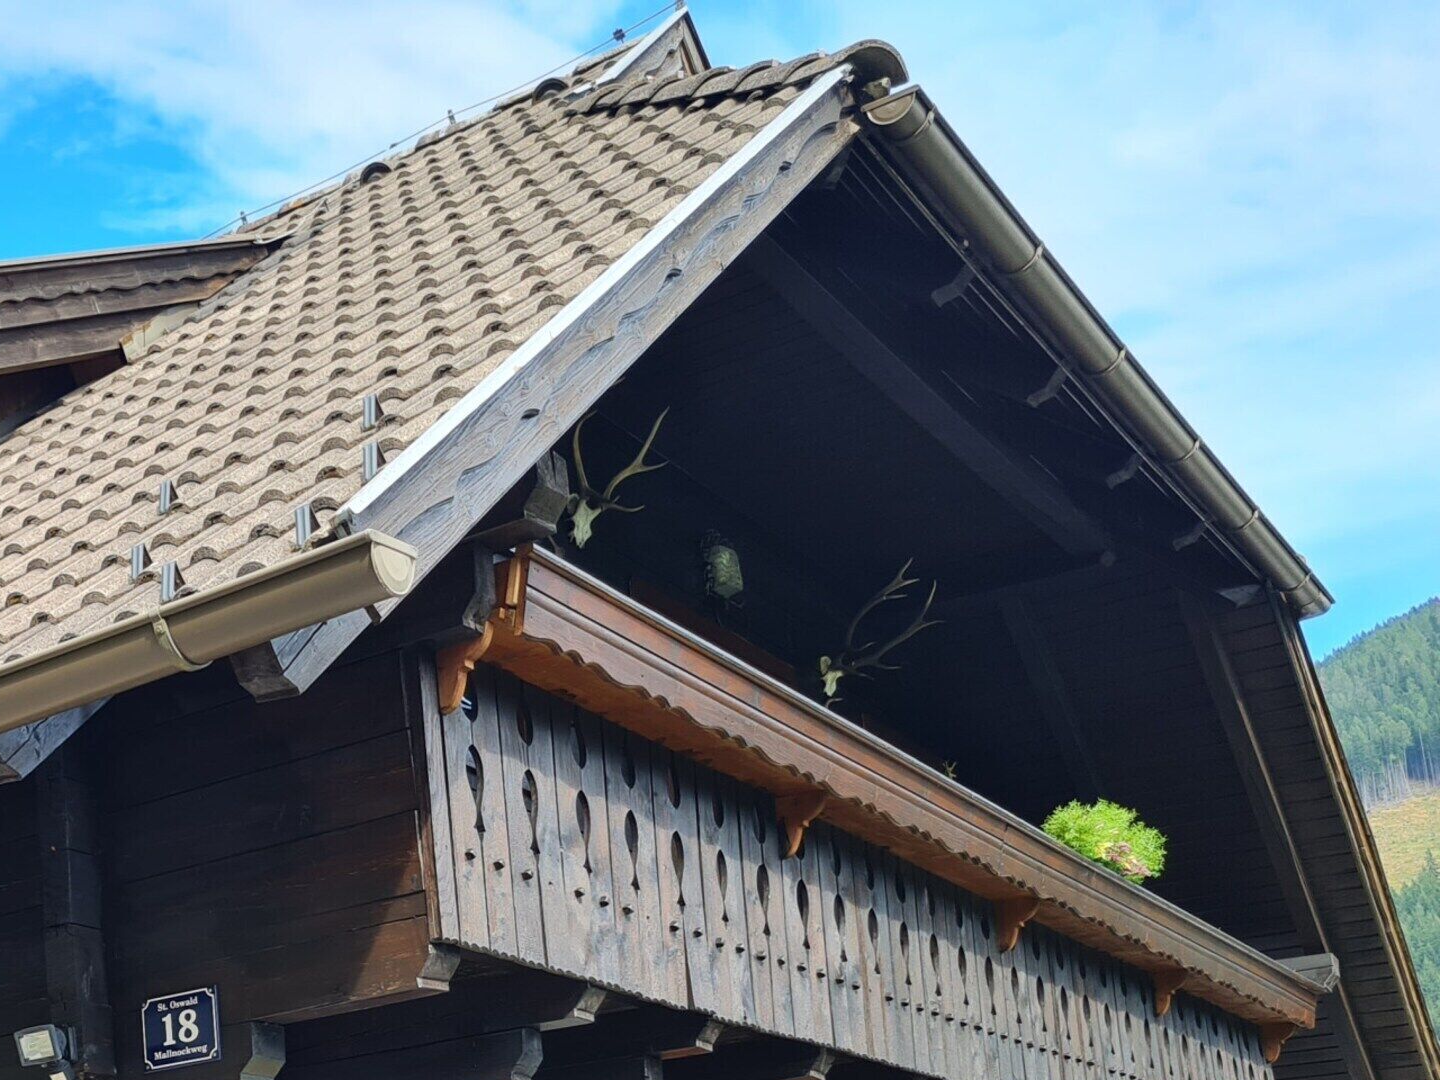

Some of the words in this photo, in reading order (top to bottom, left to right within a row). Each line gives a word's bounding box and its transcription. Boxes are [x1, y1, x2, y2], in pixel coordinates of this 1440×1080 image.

[157, 1002, 168, 1012] St.
[169, 996, 198, 1009] Oswald
[161, 1008, 199, 1046] 18
[154, 1044, 208, 1061] Mallnockweg
